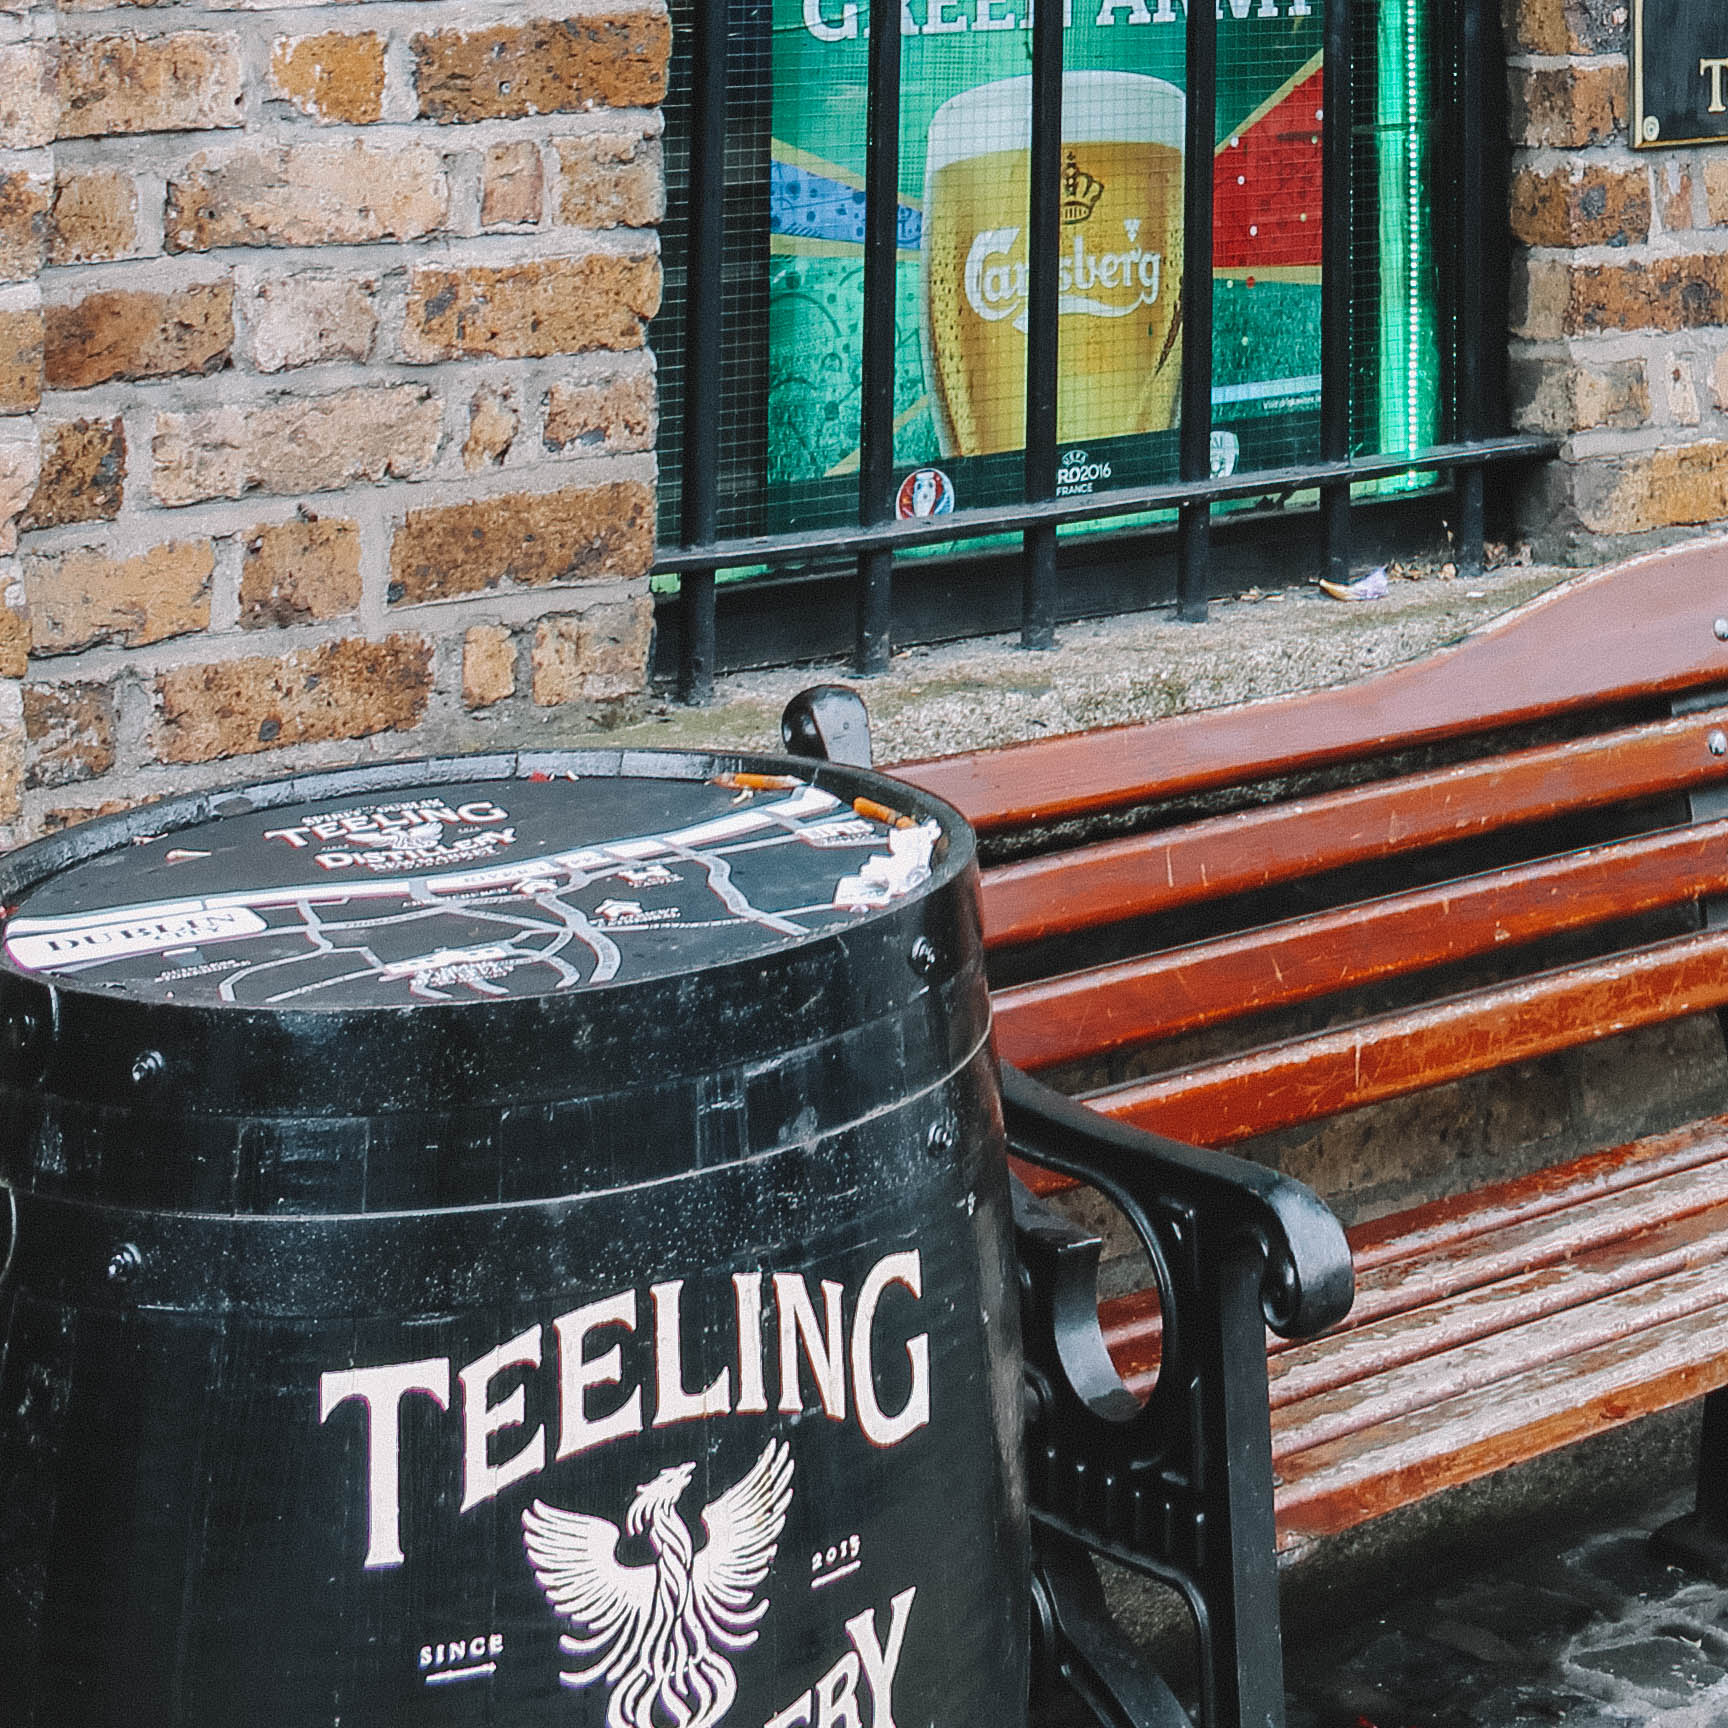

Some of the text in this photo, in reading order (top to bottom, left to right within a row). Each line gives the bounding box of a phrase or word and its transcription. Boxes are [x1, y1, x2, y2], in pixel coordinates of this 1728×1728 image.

[964, 226, 1162, 322] Carsberg
[1056, 482, 1094, 497] FRANCE
[1057, 461, 1112, 485] RO2016
[263, 800, 510, 849] TEELING
[314, 827, 518, 871] DISTILLERY
[47, 913, 236, 952] DUBLIN
[153, 924, 220, 940] CITY
[320, 1247, 930, 1570] TEELING
[419, 1632, 504, 1667] SINCE
